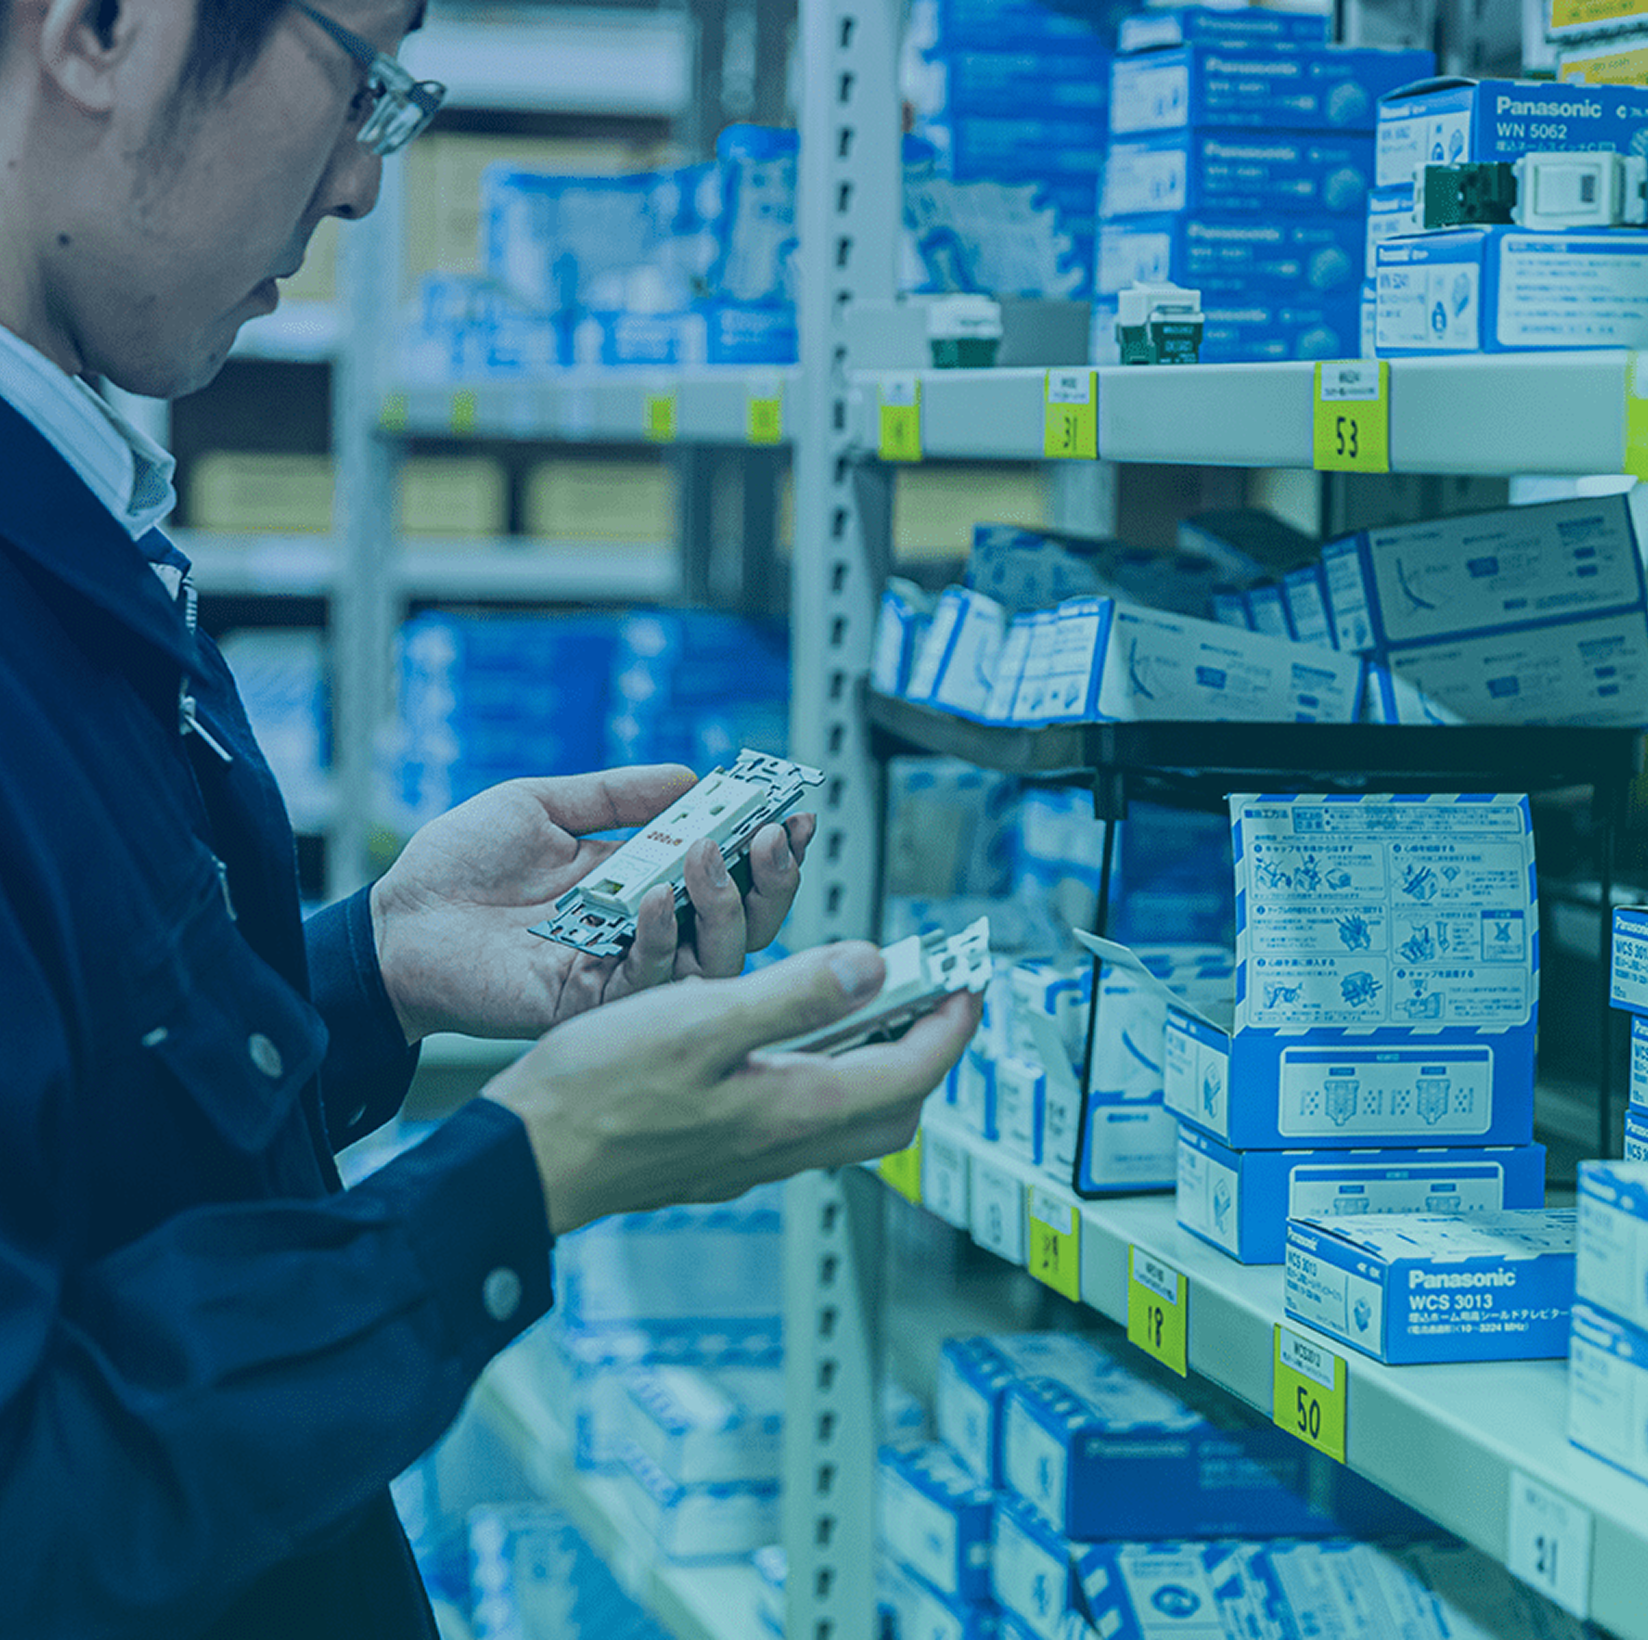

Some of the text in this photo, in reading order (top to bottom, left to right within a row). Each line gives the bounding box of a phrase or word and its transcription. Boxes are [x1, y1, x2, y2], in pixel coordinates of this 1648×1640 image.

[1496, 96, 1602, 117] Panasonic
[1496, 123, 1568, 139] WN 5062
[1336, 416, 1358, 458] 53
[1408, 1268, 1516, 1289] Panasonic
[1408, 1294, 1493, 1310] WCS 3013
[1297, 1385, 1320, 1440] 50
